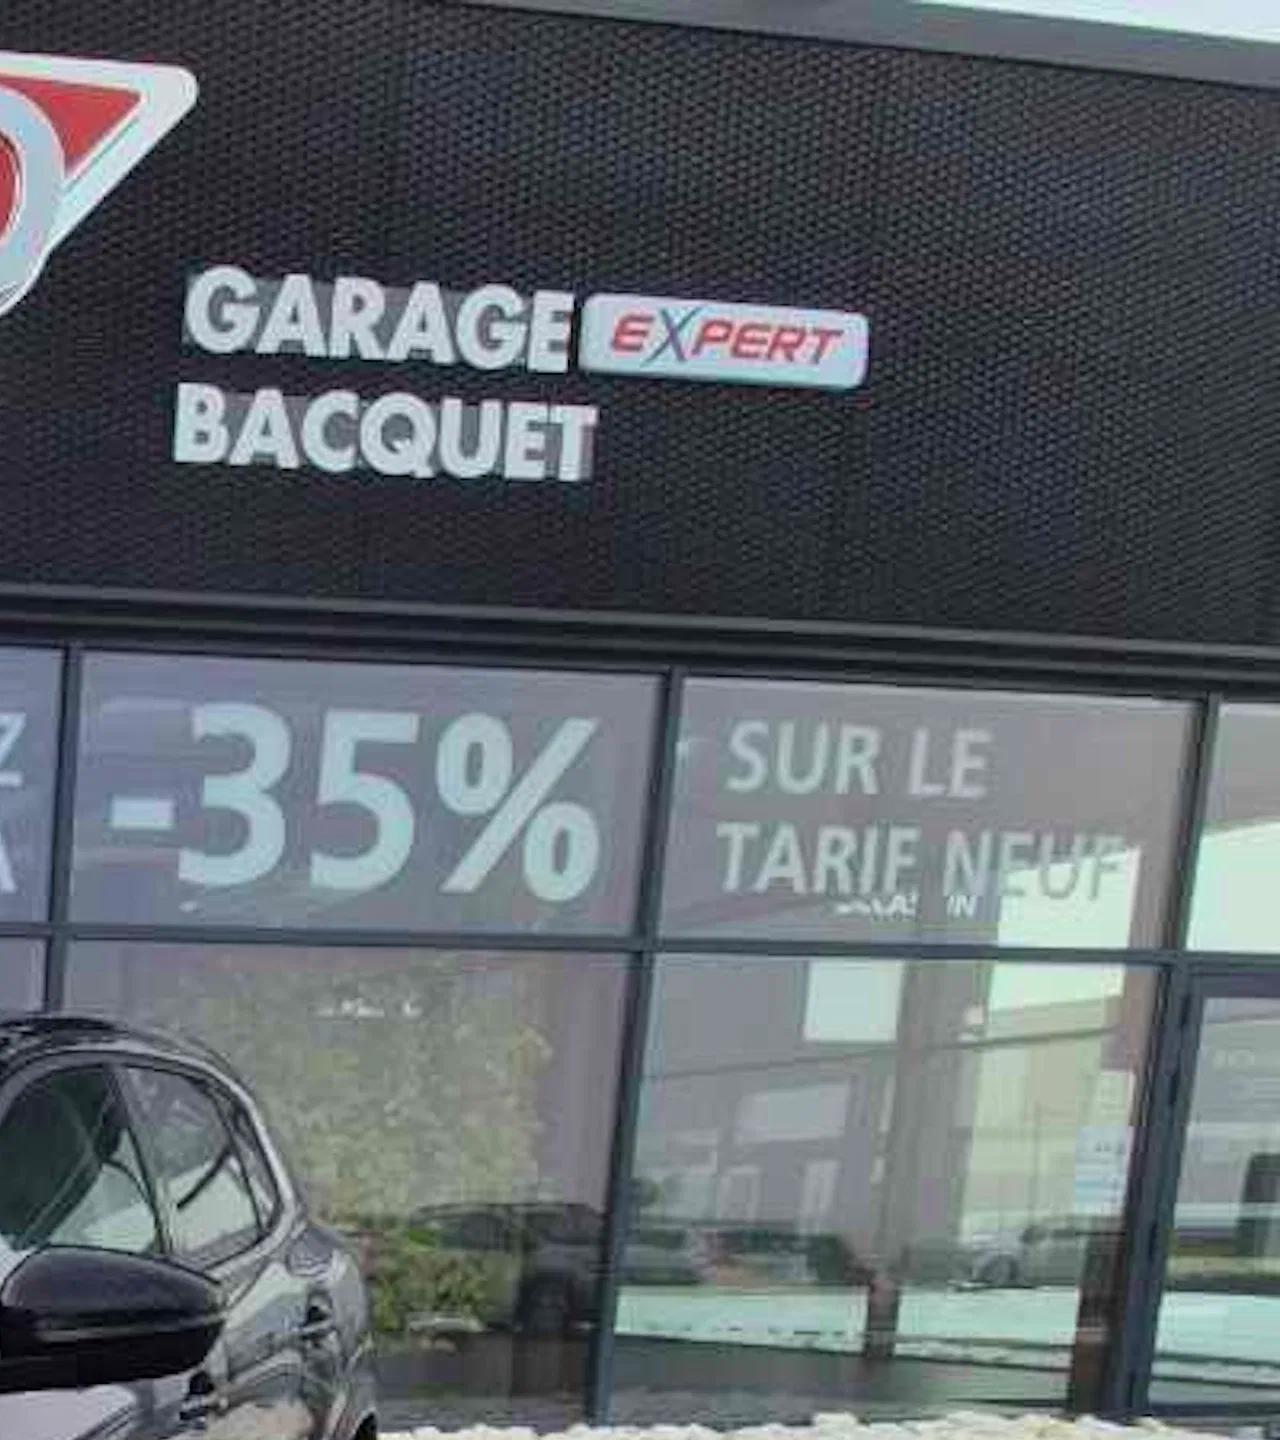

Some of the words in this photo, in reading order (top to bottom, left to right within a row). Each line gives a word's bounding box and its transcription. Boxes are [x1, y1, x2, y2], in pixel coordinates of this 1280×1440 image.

[183, 265, 573, 373] GARAGE
[173, 383, 599, 482] BACQUET
[109, 702, 601, 901] -35%
[727, 720, 880, 796] SUR
[910, 729, 994, 798] LE
[716, 822, 922, 895] TARIF
[942, 829, 1128, 898] NEUF
